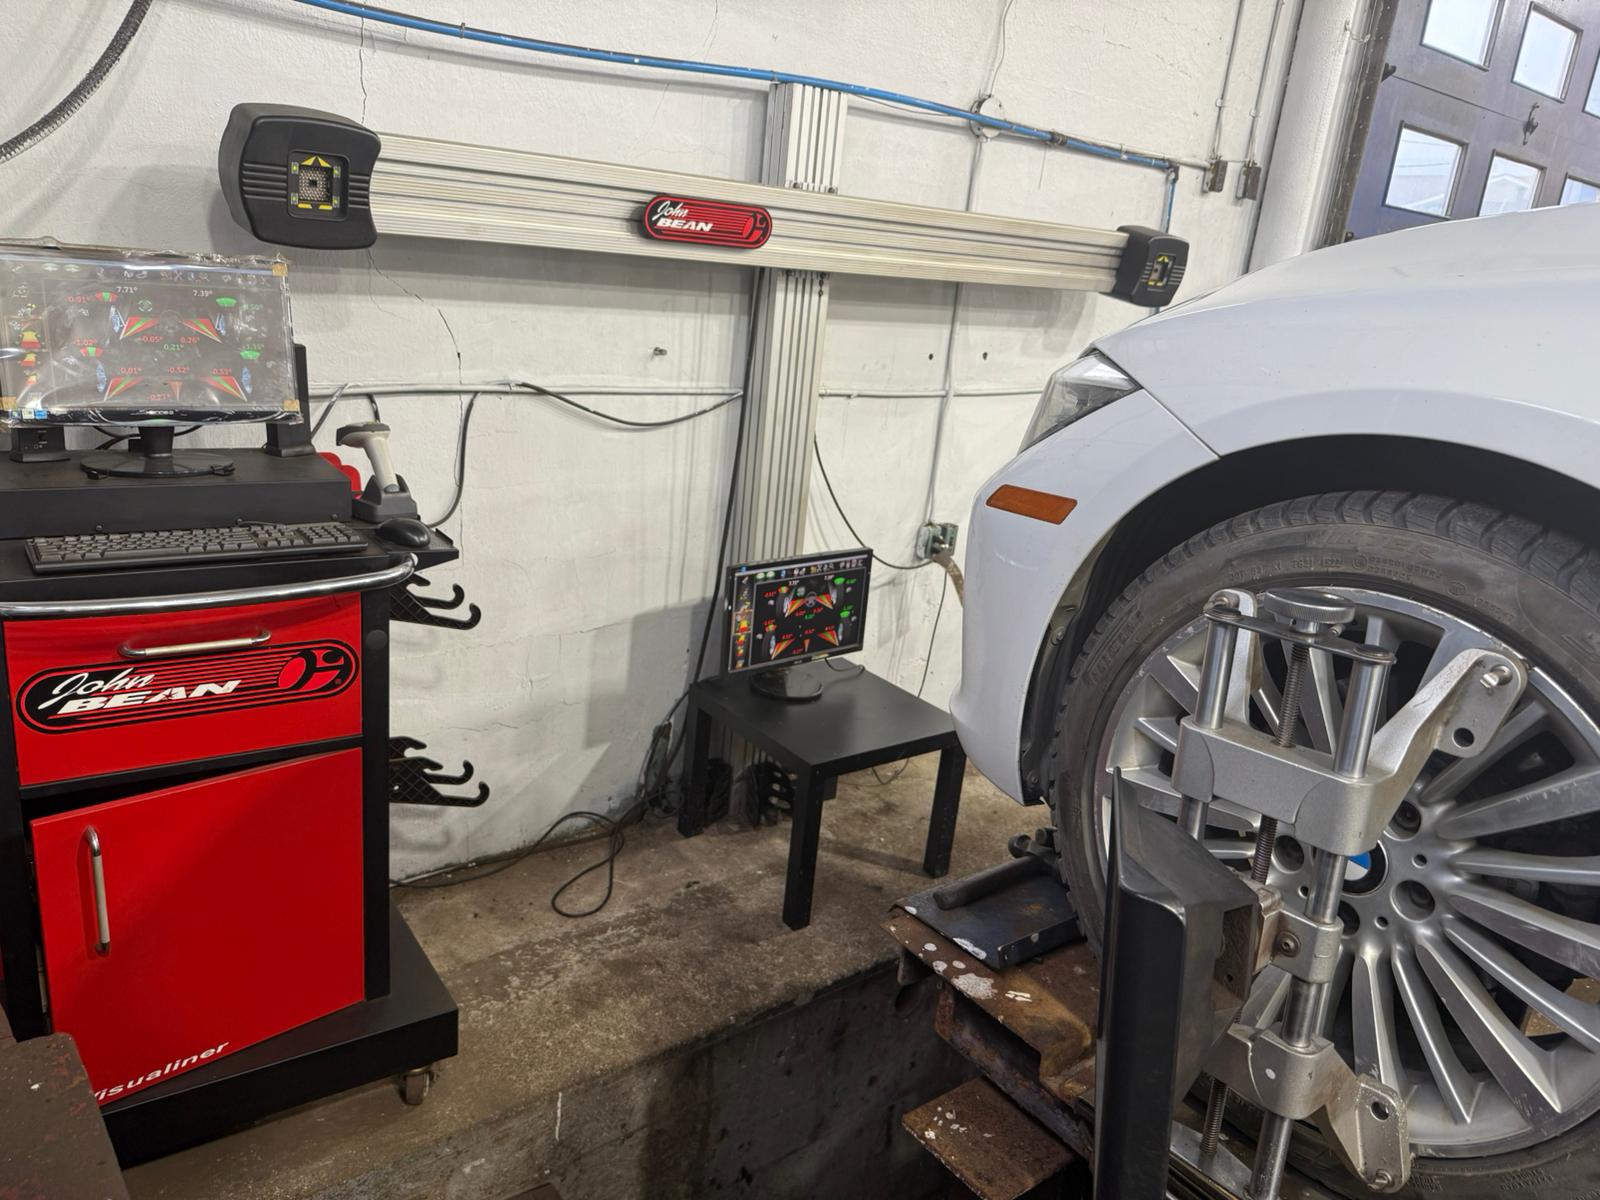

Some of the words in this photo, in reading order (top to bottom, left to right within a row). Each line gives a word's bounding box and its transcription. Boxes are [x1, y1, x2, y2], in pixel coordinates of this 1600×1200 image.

[651, 200, 689, 221] John
[656, 217, 713, 232] BEAN
[38, 667, 155, 710] John
[57, 680, 242, 714] BEAN
